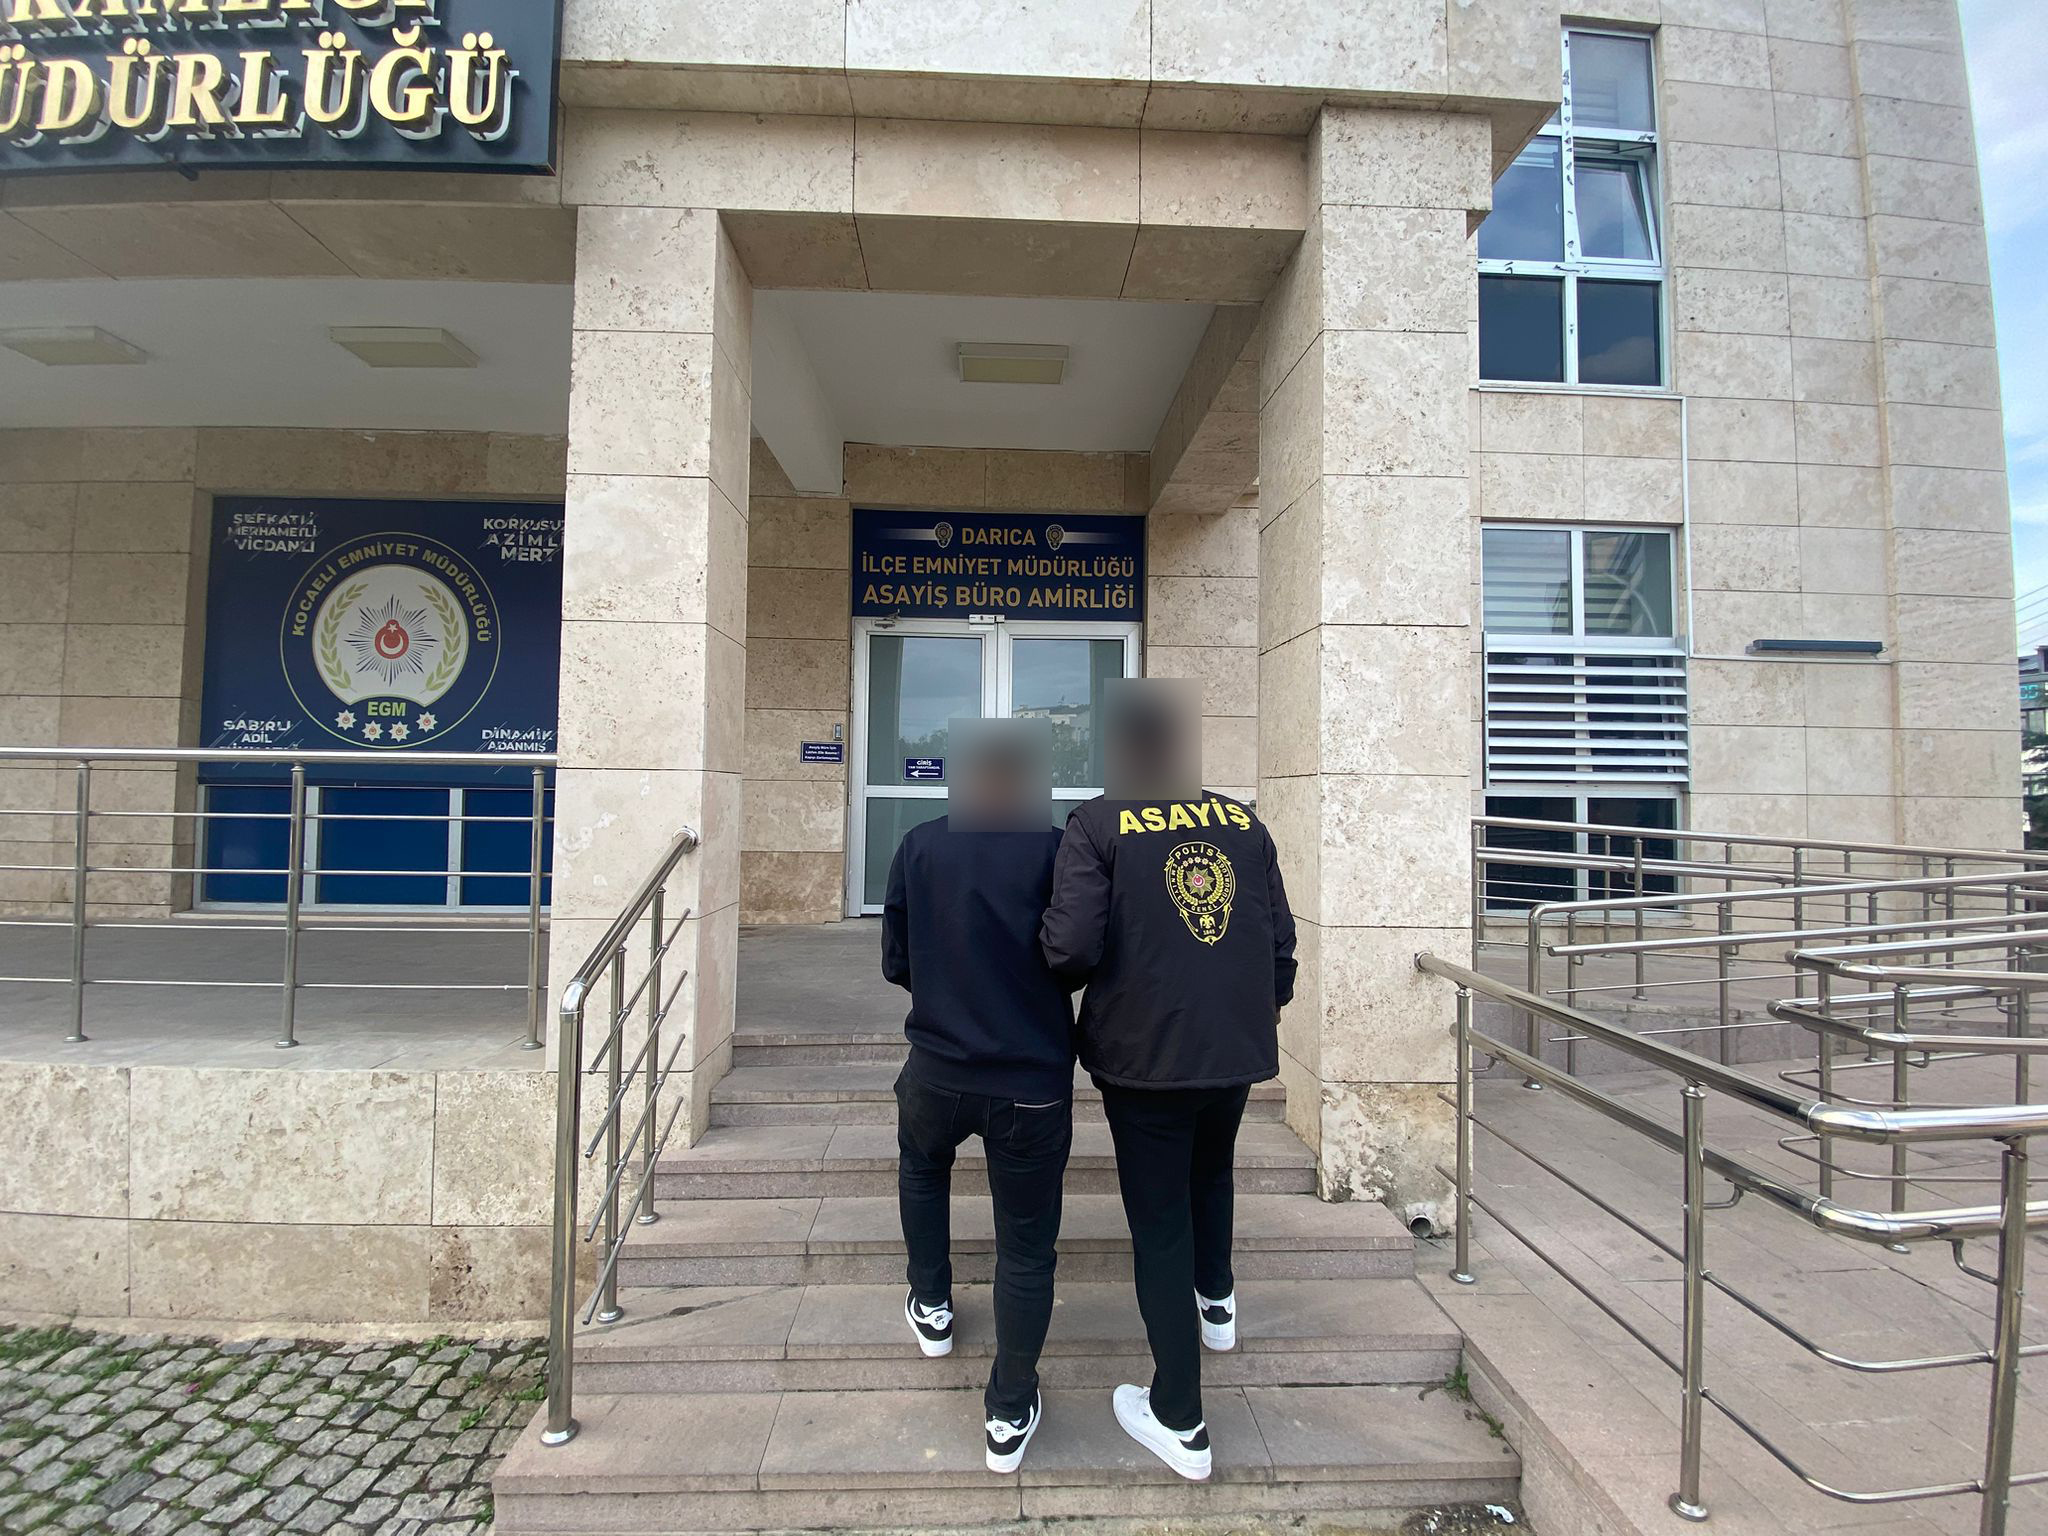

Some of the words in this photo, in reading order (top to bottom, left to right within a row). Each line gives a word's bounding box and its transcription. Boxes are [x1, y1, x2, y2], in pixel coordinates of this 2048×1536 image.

[962, 527, 1036, 546] DARICA
[500, 546, 556, 562] MERT
[862, 551, 907, 576] İLÇE
[913, 553, 1002, 576] EMNİYET
[1007, 556, 1135, 578] MÜDÜRLÜĞÜ
[293, 564, 338, 637] KOCAELİ
[337, 541, 420, 570] EMNİYET
[422, 548, 492, 642] MÜDÜRLÜĞÜ
[862, 581, 949, 609] ASAYİŞ
[955, 581, 1021, 608] BÜRO
[1027, 583, 1134, 609] AMİRLİĞİ
[367, 701, 406, 717] EGM
[241, 730, 273, 744] ADİL
[481, 726, 554, 741] DİNAMİK
[1119, 797, 1252, 835] ASAYİŞ
